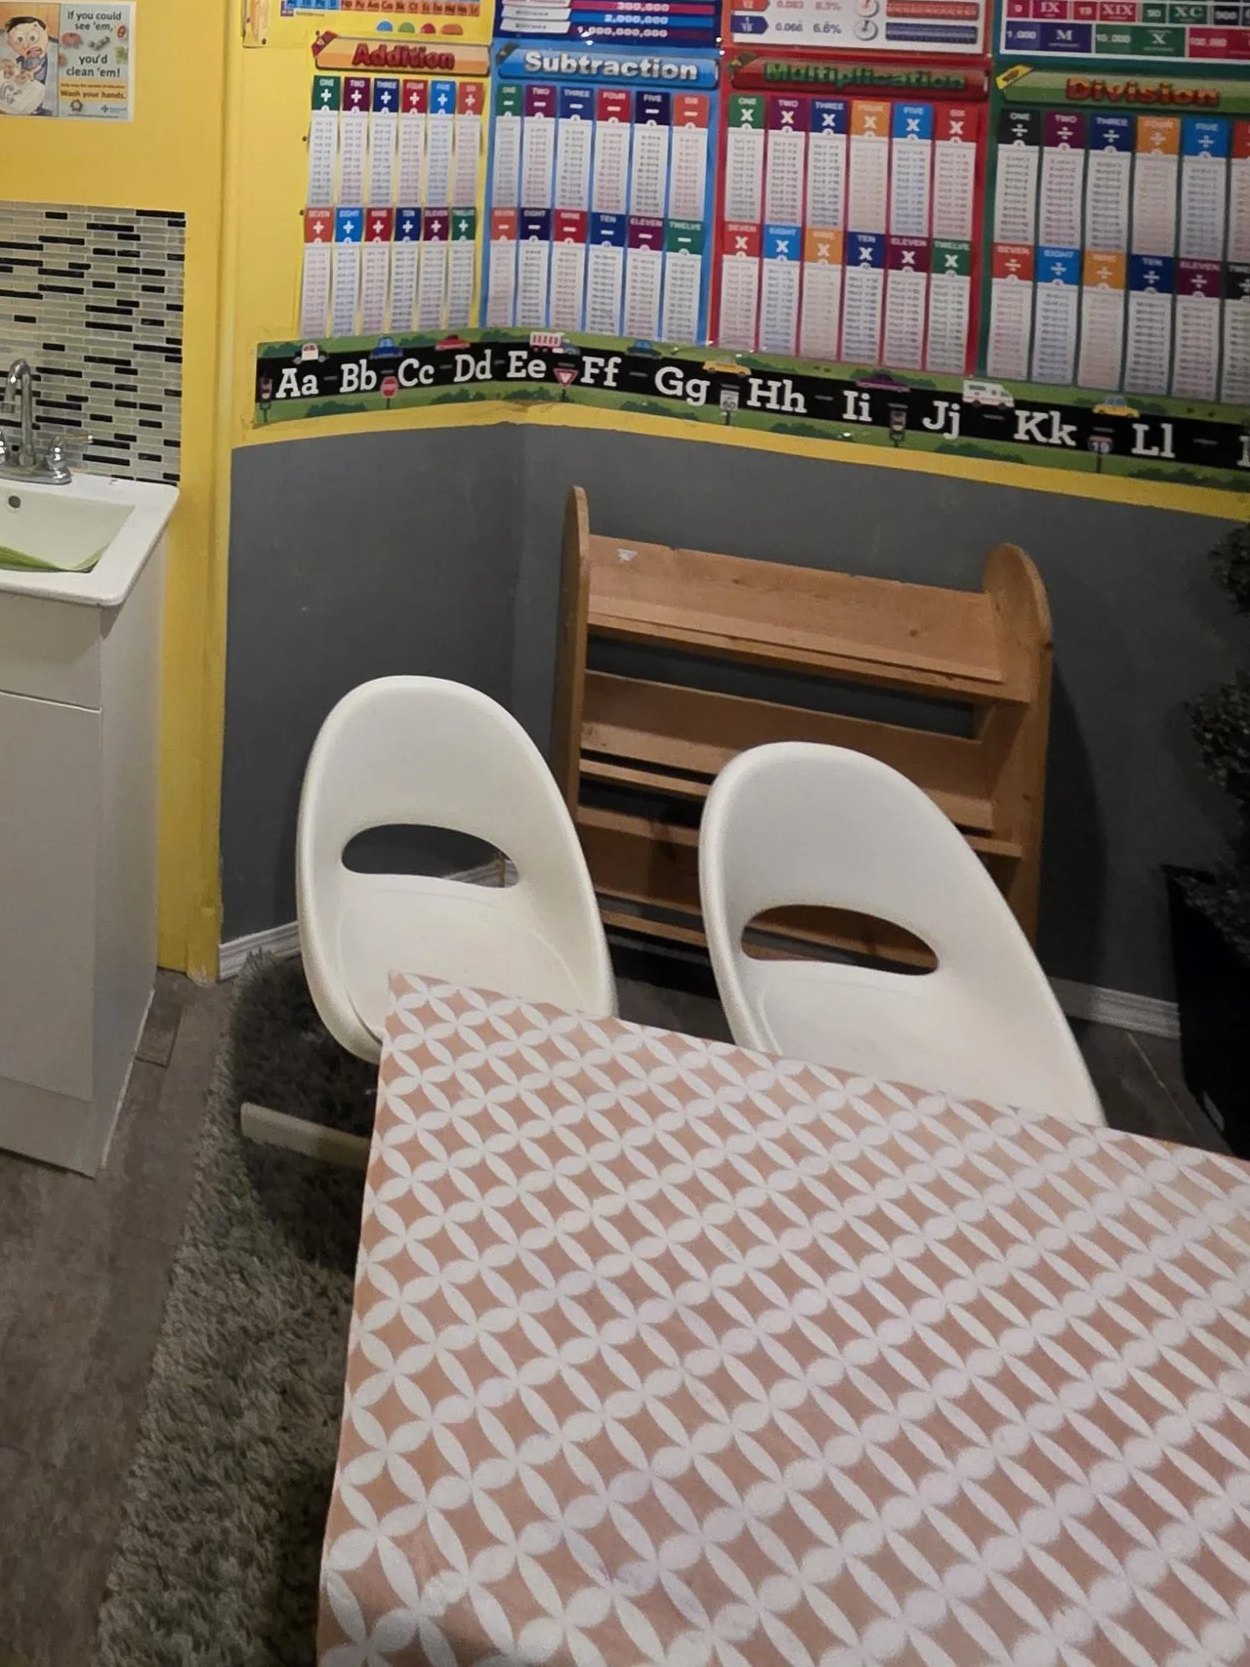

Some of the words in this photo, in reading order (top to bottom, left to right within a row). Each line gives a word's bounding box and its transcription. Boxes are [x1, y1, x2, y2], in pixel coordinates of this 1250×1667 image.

[617, 2, 669, 12] 300,000
[1041, 2, 1059, 12] IX
[1103, 4, 1133, 15] XIX
[68, 11, 74, 19] If
[76, 13, 93, 21] you
[96, 12, 121, 20] could
[1175, 7, 1202, 17] XC
[604, 15, 669, 24] 2,000,000
[93, 23, 113, 32] 'em,
[1056, 30, 1073, 41] M
[79, 54, 107, 64] you'd
[352, 43, 455, 70] Addition
[525, 51, 698, 80] Subtraction
[66, 67, 94, 76] clean
[98, 67, 120, 77] 'em!
[764, 62, 965, 91] Multiplication
[565, 90, 590, 98] THREE
[603, 92, 626, 100] FOUR
[1065, 77, 1220, 107] Division
[644, 94, 662, 102] FIVE
[738, 97, 756, 105] ONE
[778, 99, 799, 107] TWO
[815, 102, 844, 110] THREE
[904, 107, 923, 115] FIVE
[1010, 113, 1030, 121] ONE
[1055, 114, 1077, 123] TWO
[1096, 117, 1128, 126] THREE
[630, 219, 662, 227] ELEVEN
[670, 221, 701, 231] TWELVE
[728, 224, 756, 233] SEVEN
[857, 235, 876, 243] TEN
[891, 238, 927, 247] ELEVEN
[934, 241, 969, 251] TWELVE
[997, 245, 1030, 255] SEVEN
[1142, 258, 1162, 266] TEN
[1179, 261, 1220, 271] ELEVEN
[276, 368, 319, 399] Aa
[339, 359, 377, 393] Bb
[398, 357, 434, 387] Cc
[453, 349, 492, 383] Dd
[506, 350, 547, 378] Ee
[580, 356, 622, 387] Ff
[655, 366, 710, 406] Gg
[747, 378, 807, 414] Hh
[842, 390, 872, 422] Ii
[923, 400, 961, 440] Jj
[1014, 410, 1077, 446] Kk
[1131, 423, 1175, 458] Ll
